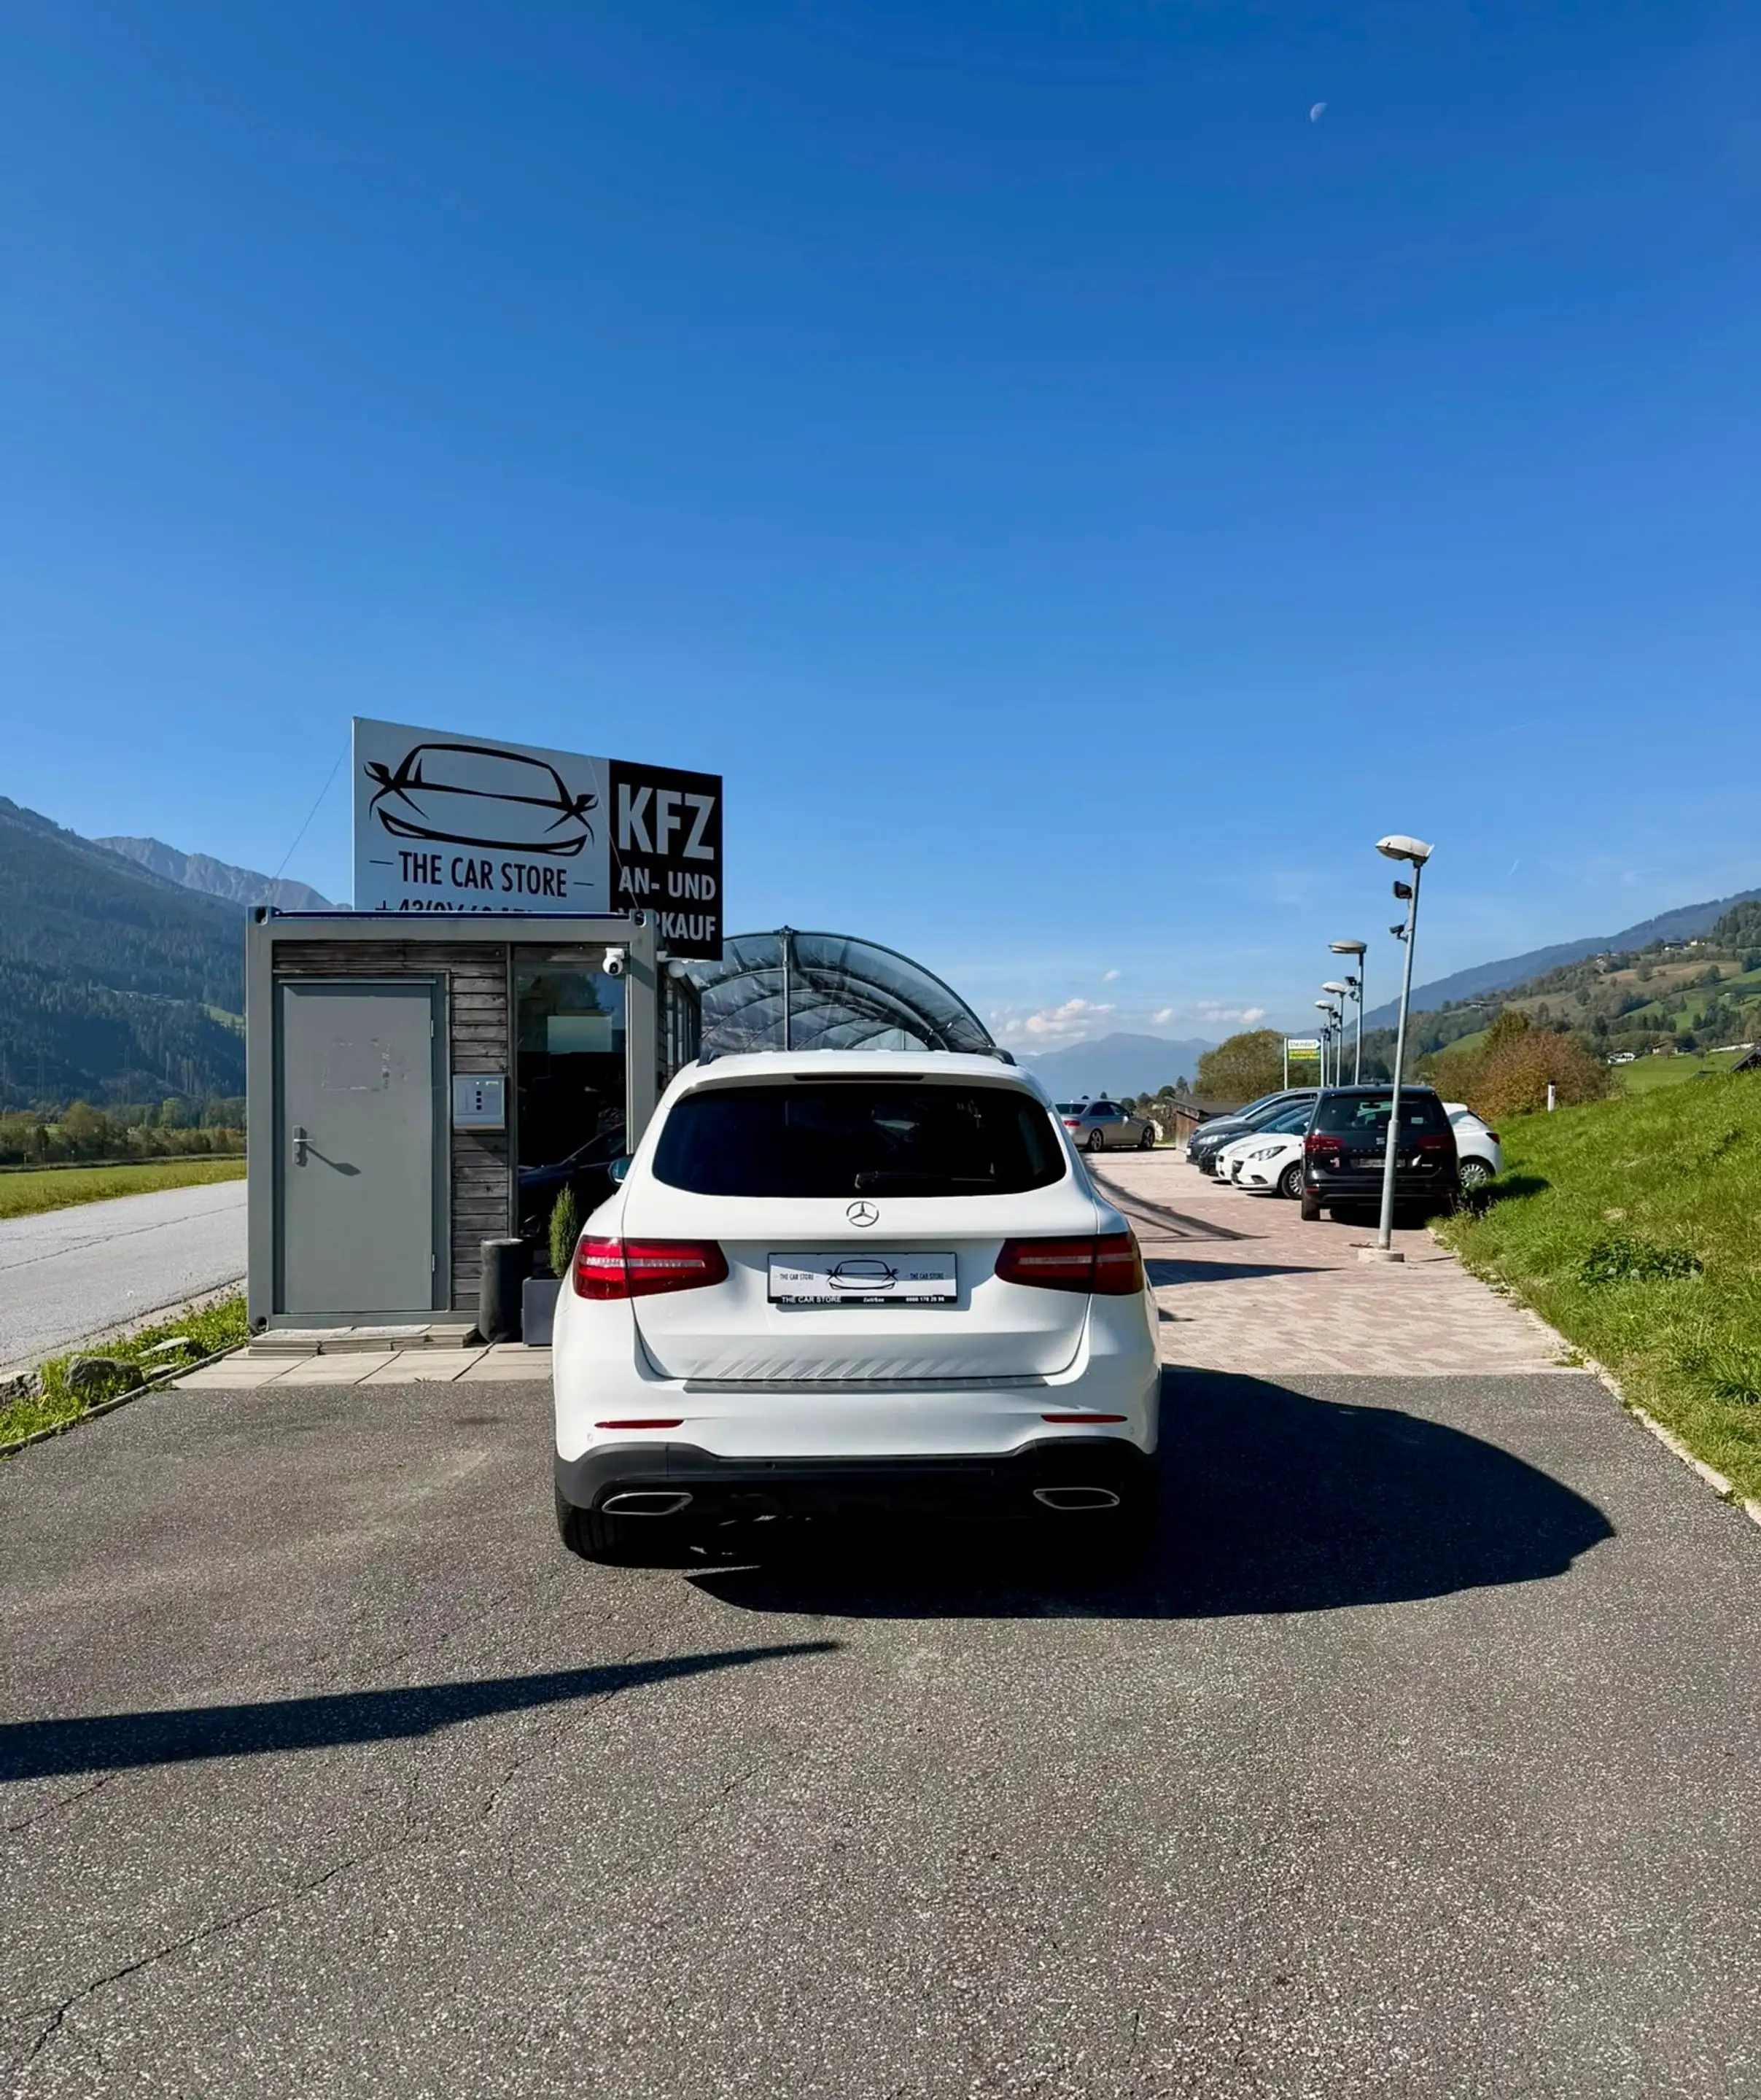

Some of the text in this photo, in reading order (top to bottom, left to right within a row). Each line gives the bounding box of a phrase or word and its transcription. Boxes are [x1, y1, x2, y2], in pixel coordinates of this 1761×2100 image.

[618, 782, 716, 860] KFZ
[398, 850, 567, 898] THE CAR STORE
[618, 866, 716, 901] AN- UND
[618, 909, 716, 941] KAUF
[780, 1273, 814, 1281] THE CAR STORE
[782, 1296, 842, 1304] THE CAR STORE
